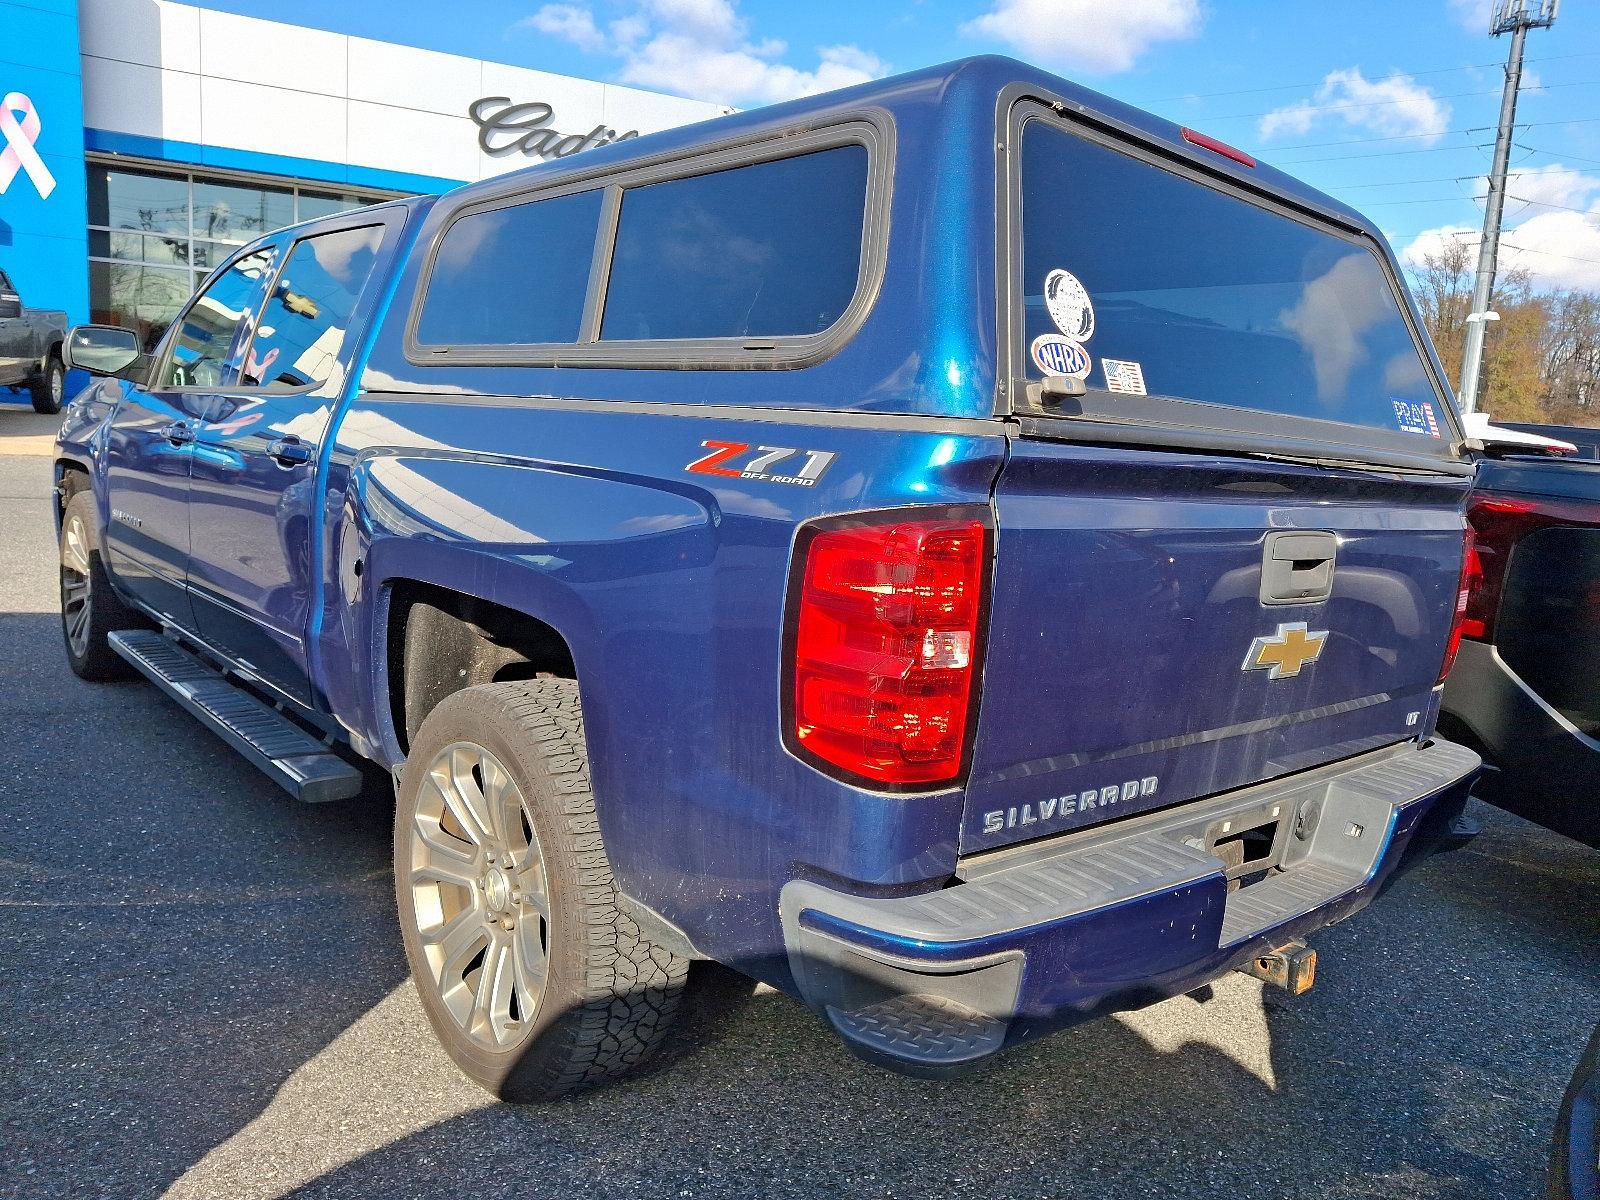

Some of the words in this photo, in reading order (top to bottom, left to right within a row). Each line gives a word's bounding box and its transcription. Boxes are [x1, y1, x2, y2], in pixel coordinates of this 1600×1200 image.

[1040, 343, 1085, 374] NHRA
[684, 440, 836, 480] Z71
[740, 471, 770, 481] OFF
[770, 474, 816, 487] ROAD
[982, 775, 1160, 835] SILVERADO
